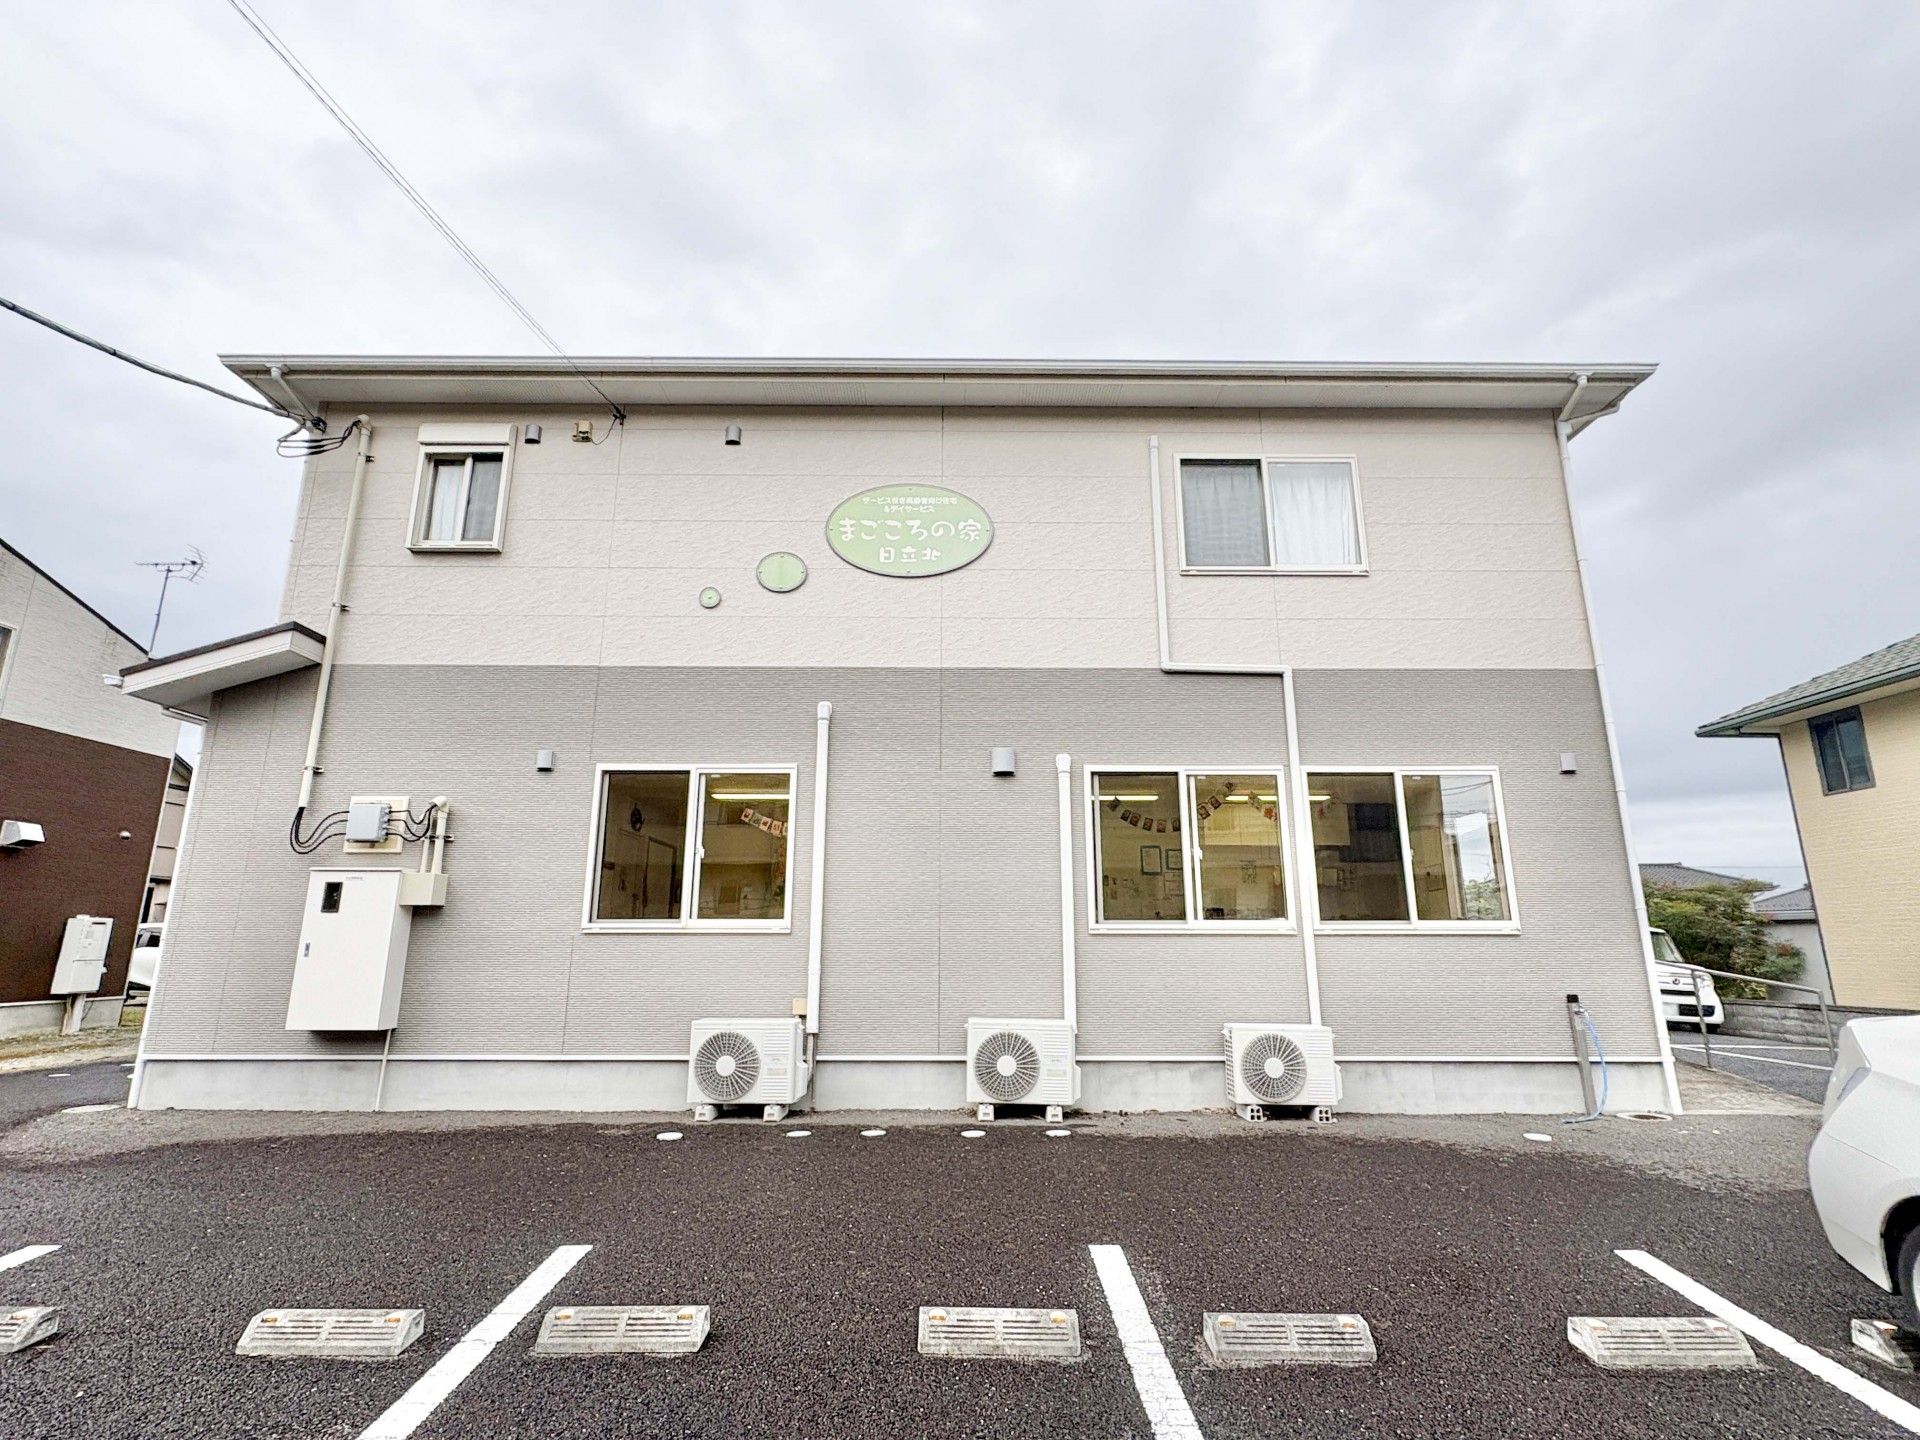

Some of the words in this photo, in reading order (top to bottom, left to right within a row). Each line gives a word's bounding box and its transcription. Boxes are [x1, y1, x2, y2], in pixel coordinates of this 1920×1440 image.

[839, 518, 982, 542] まごころの家
[879, 546, 941, 563] 日立北
